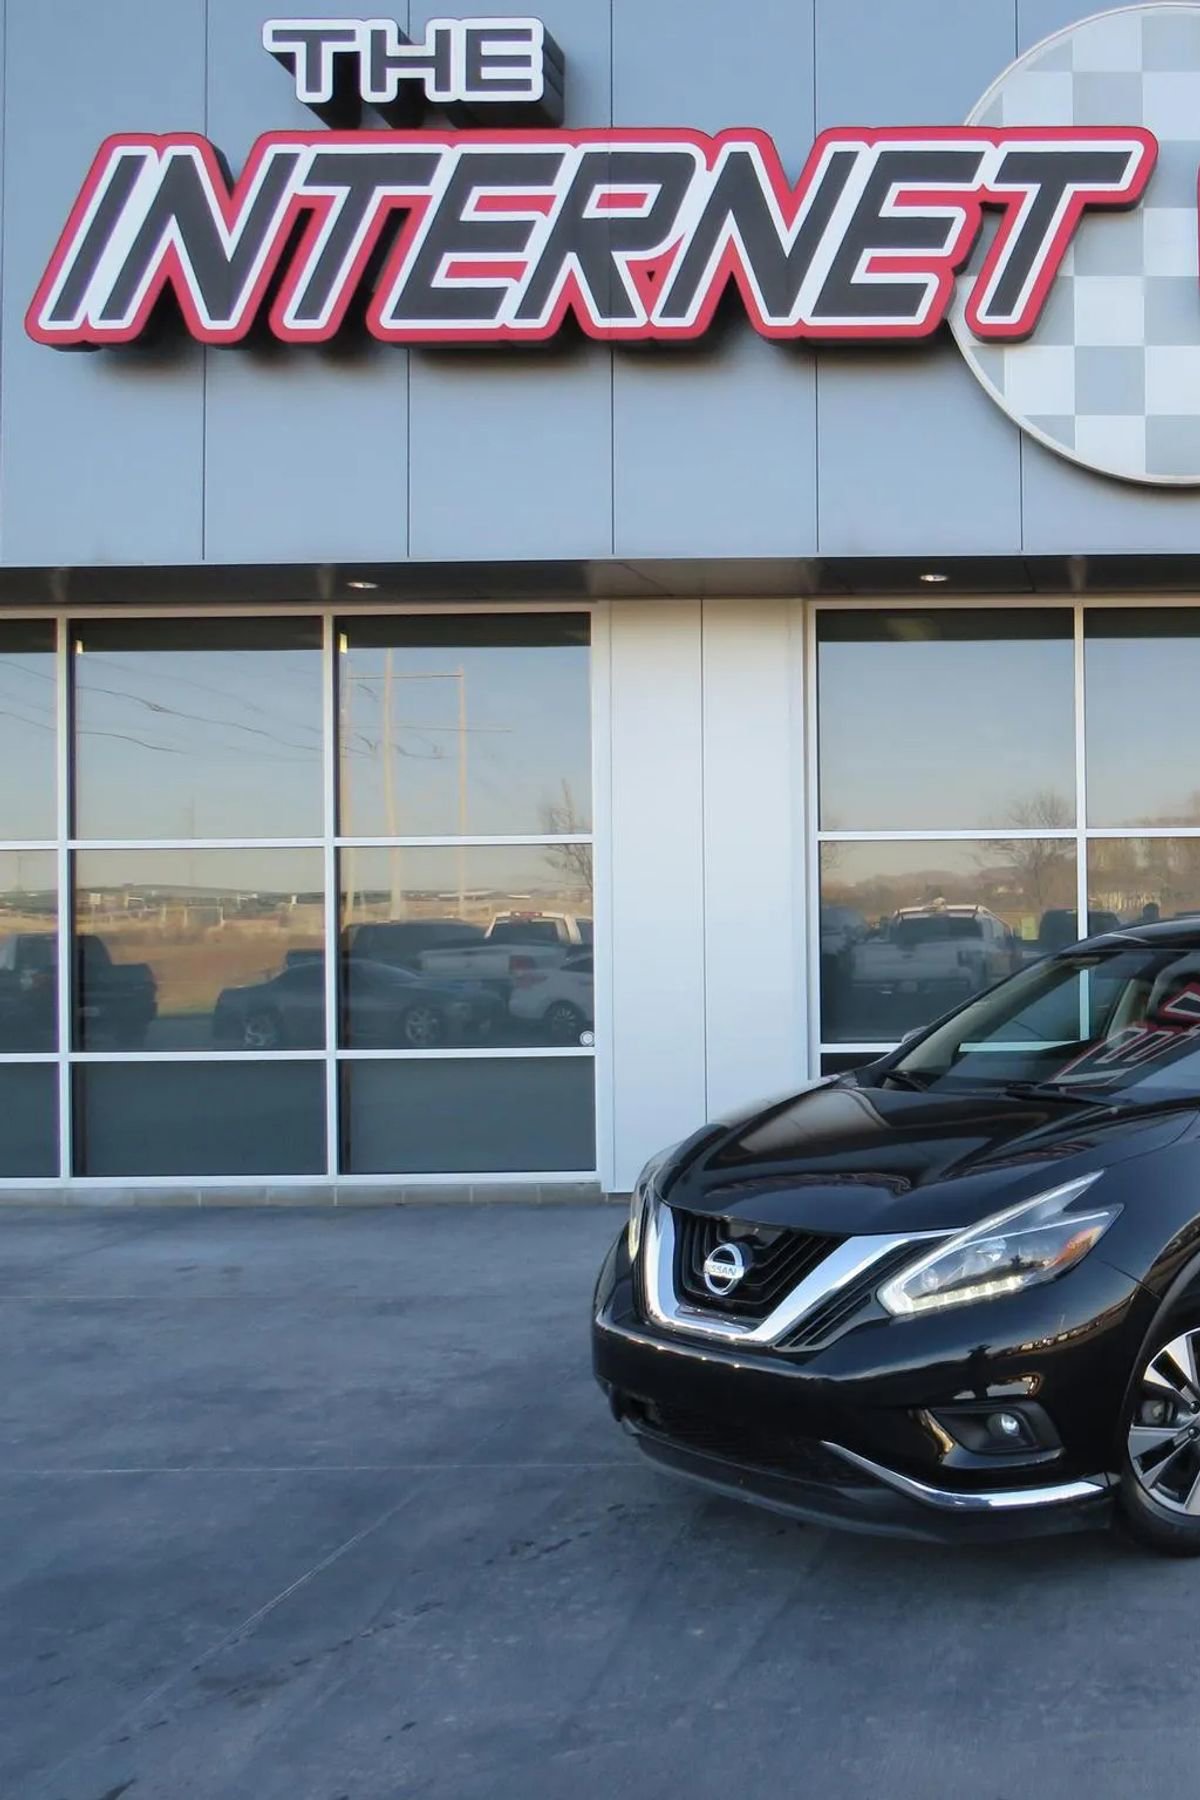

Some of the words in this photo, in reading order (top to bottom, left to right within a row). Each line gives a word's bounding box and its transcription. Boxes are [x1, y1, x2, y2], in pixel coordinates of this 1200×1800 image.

[263, 18, 545, 104] THE
[27, 128, 1157, 344] INTERNET
[705, 1263, 738, 1276] SSAN
